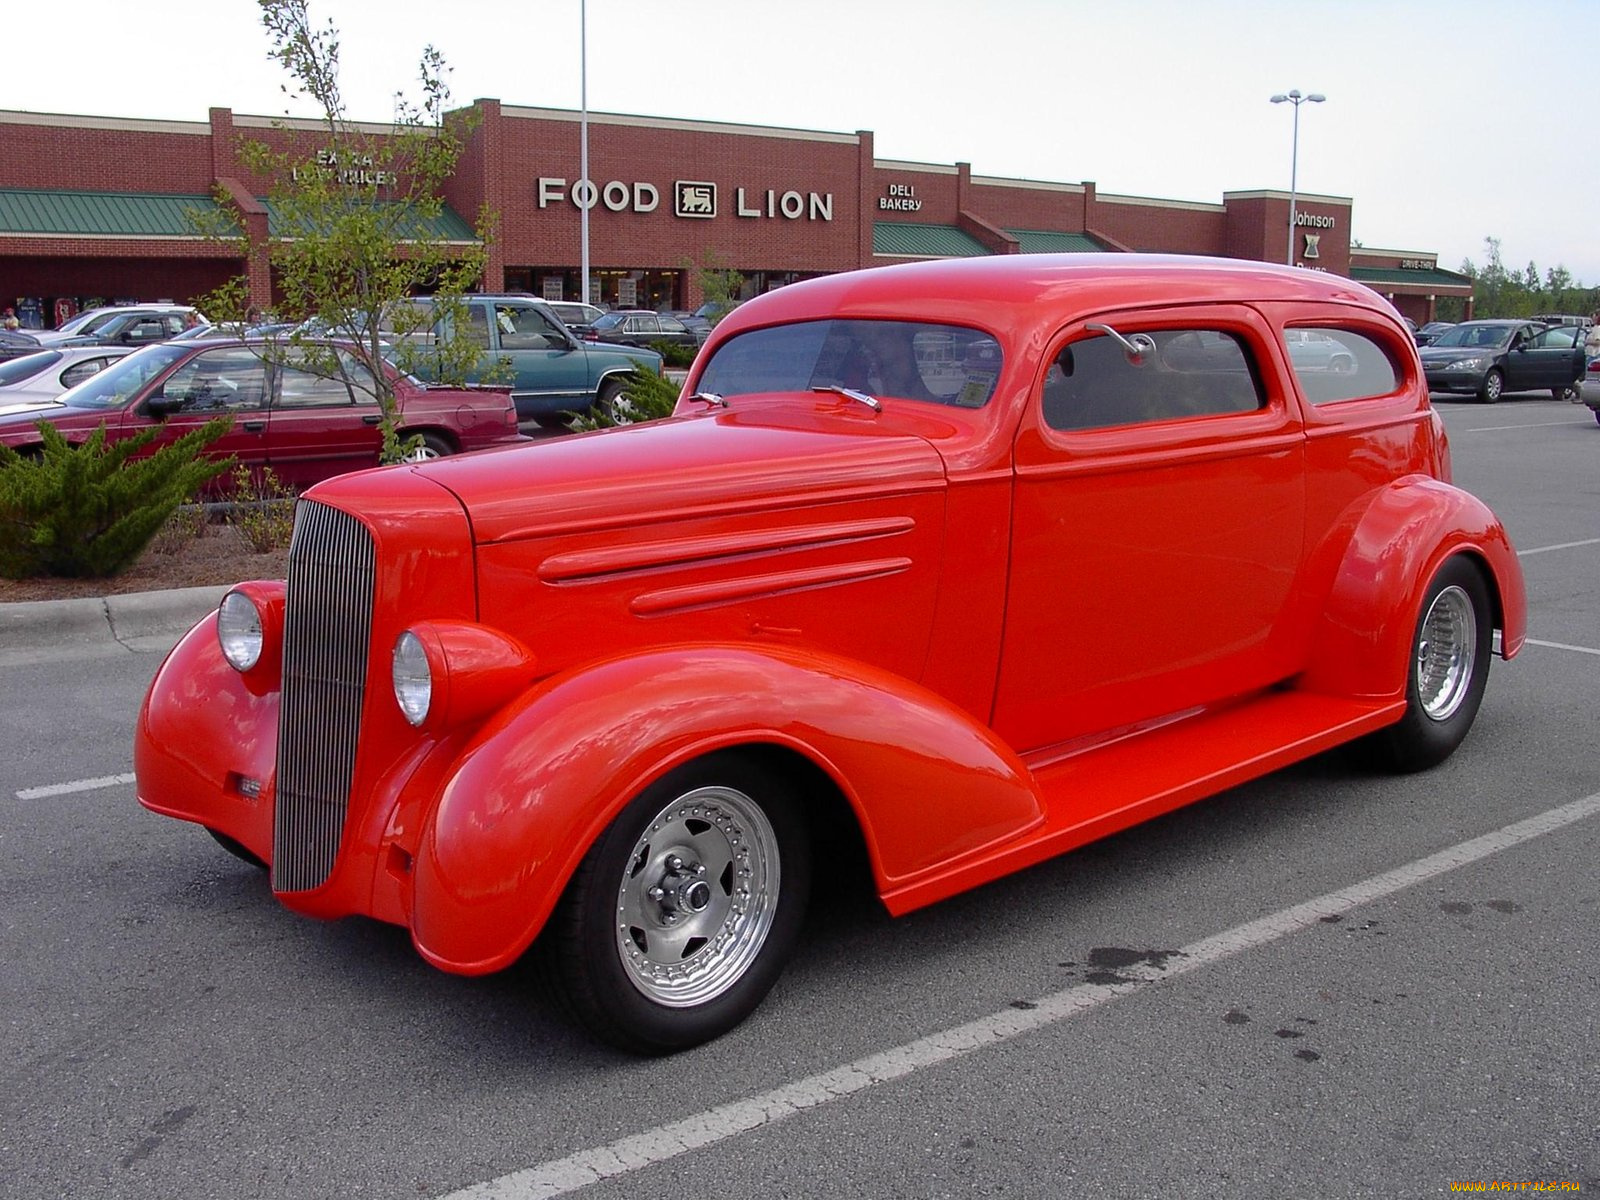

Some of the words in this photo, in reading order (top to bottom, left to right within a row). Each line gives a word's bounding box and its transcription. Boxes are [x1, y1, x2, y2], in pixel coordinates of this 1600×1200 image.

[317, 150, 374, 166] EXRA
[889, 184, 914, 197] DELI
[538, 177, 659, 212] FOOD
[738, 187, 833, 221] LION
[880, 197, 922, 211] BAKERY
[1293, 210, 1335, 228] Johnson
